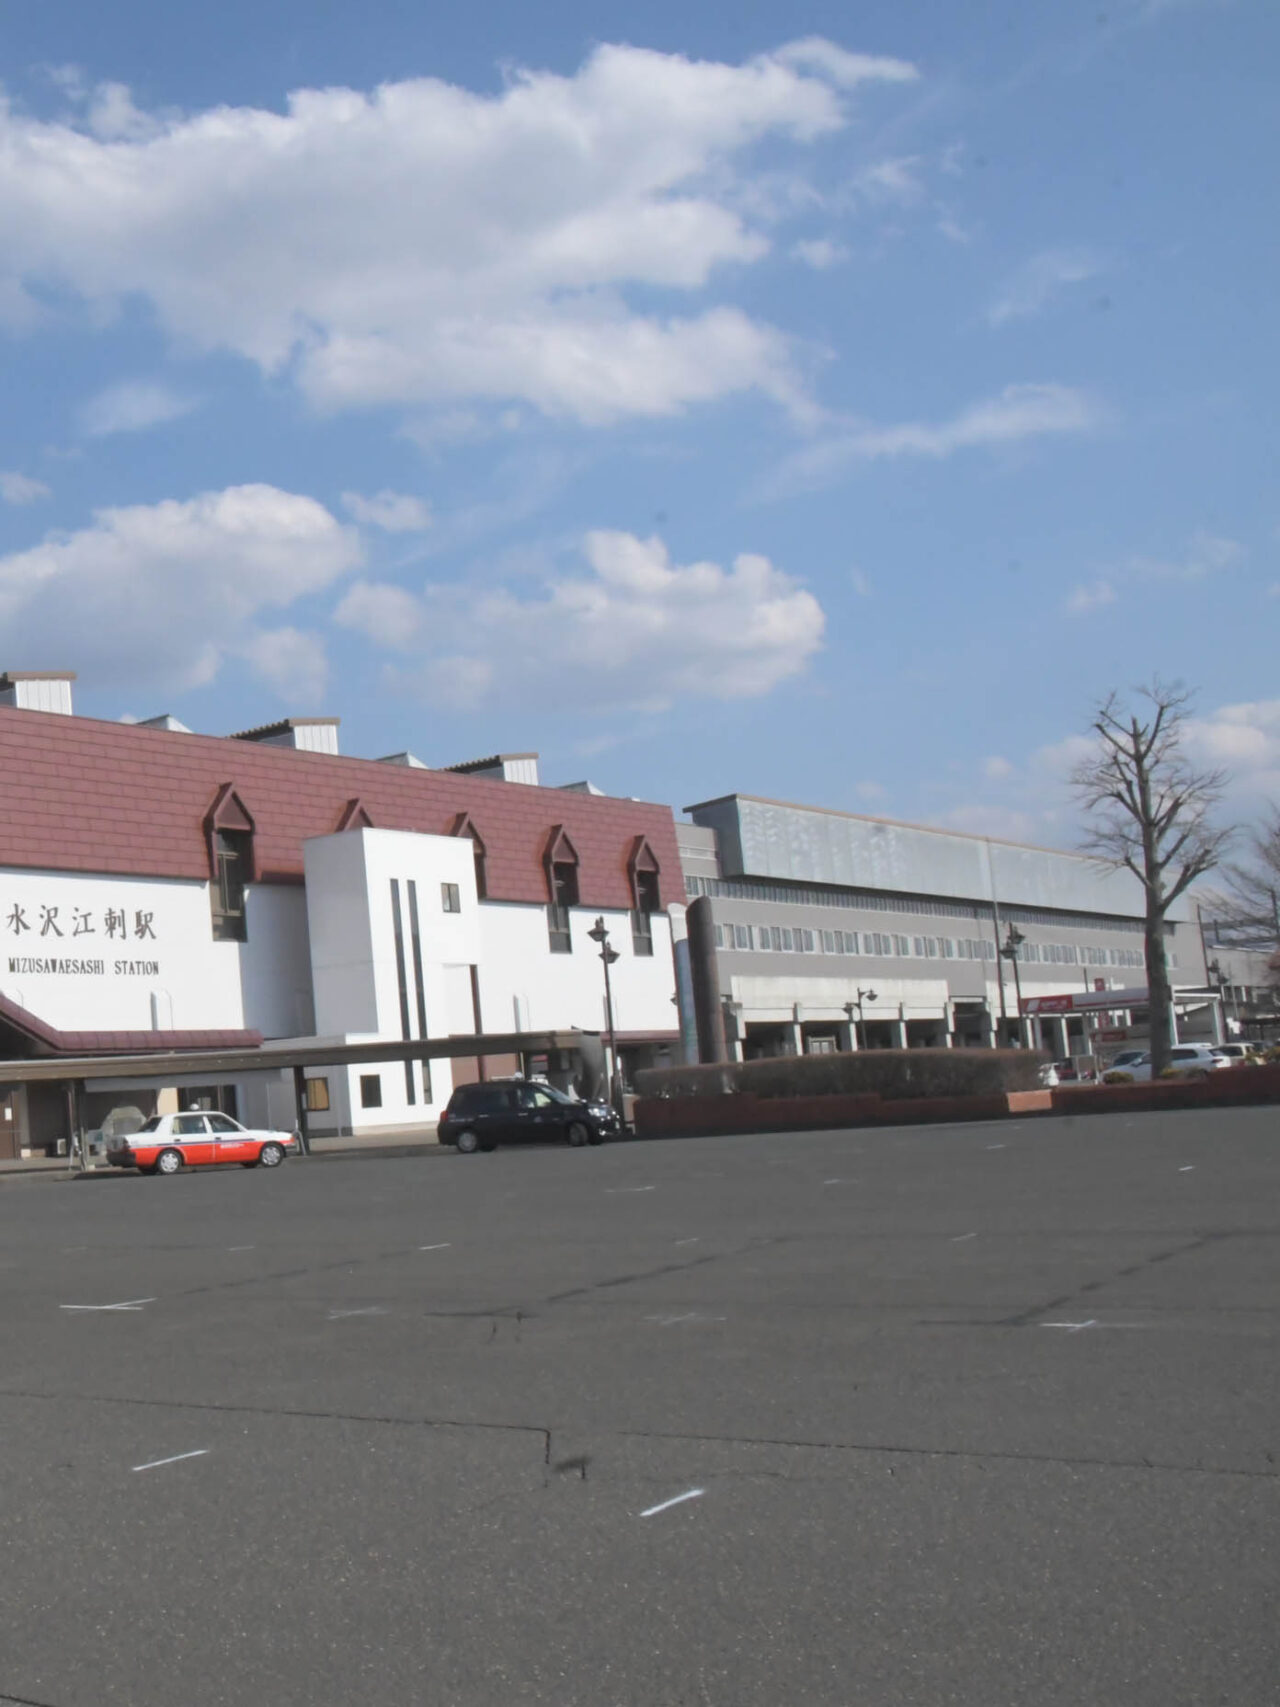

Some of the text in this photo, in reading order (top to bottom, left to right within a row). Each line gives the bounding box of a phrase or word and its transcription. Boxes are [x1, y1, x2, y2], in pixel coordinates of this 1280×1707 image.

[6, 903, 157, 940] 水沢江刺駅
[8, 957, 159, 976] MIZUSAWAESASHI STATION
